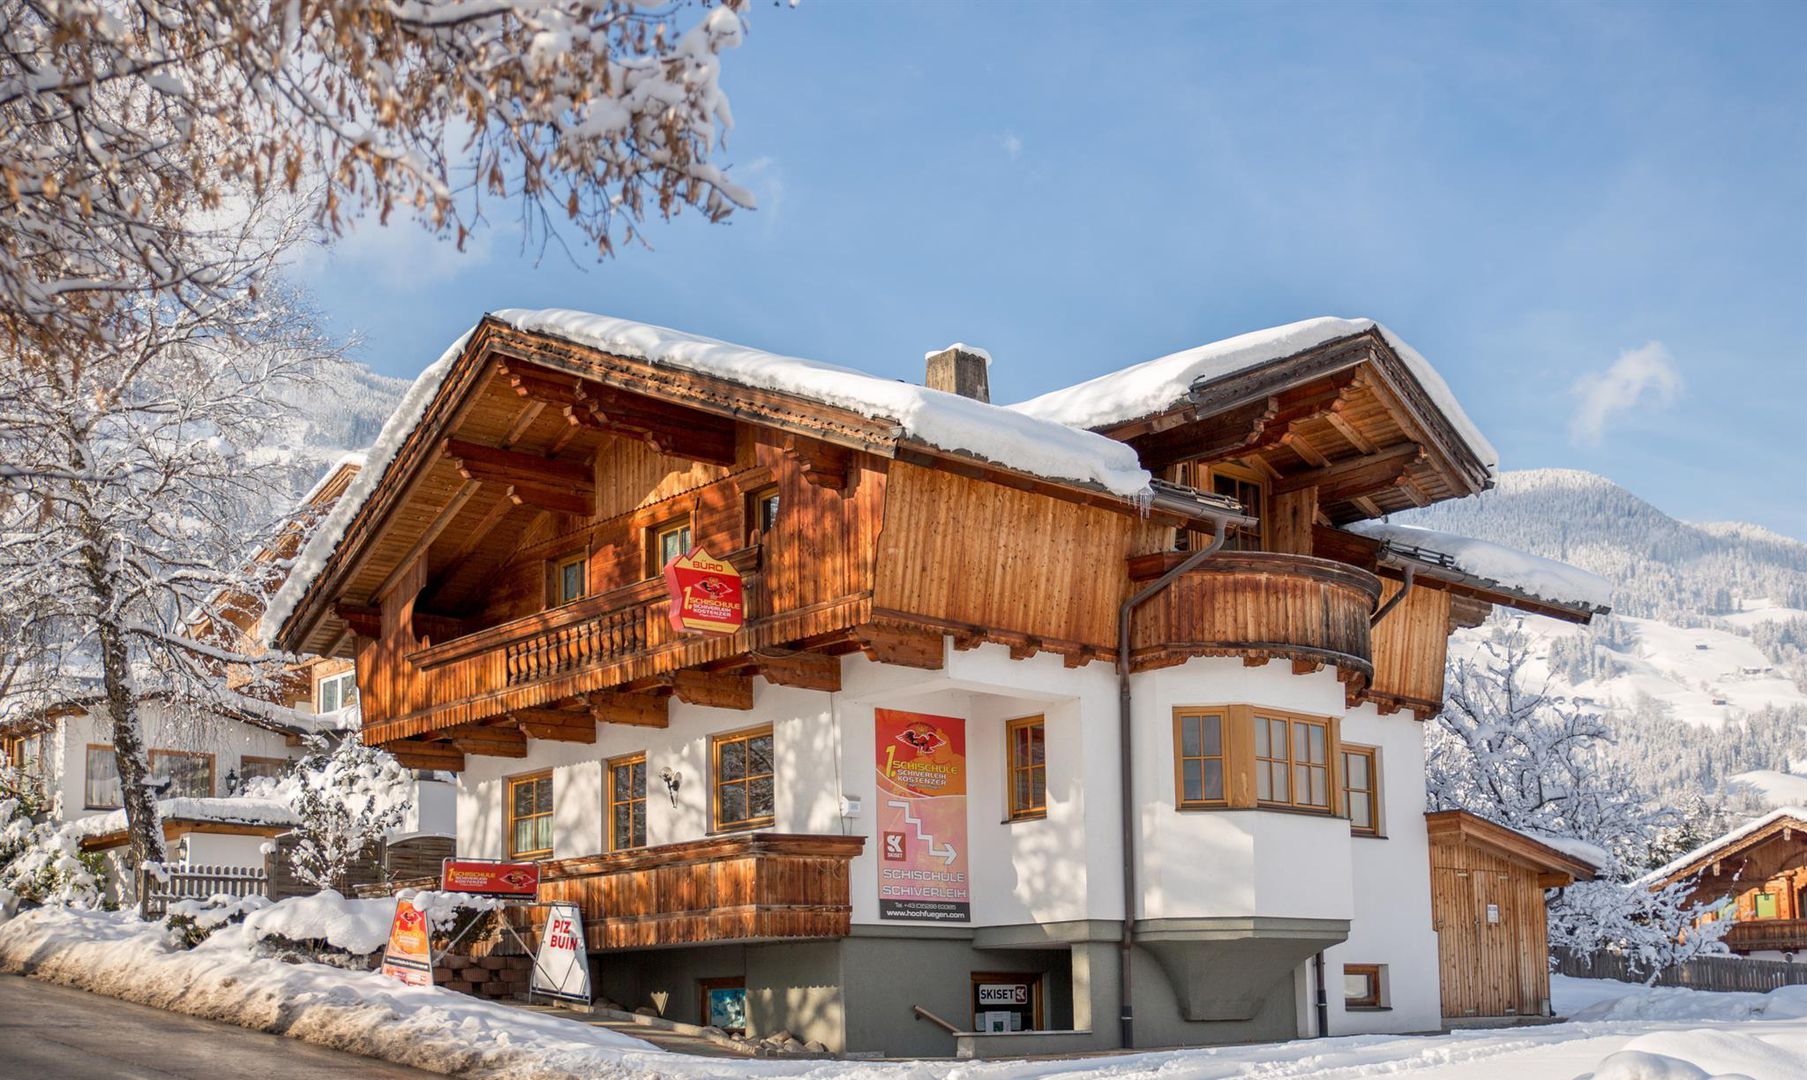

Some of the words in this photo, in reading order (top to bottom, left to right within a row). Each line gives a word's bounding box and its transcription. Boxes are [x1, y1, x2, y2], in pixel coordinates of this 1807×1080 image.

[693, 559, 724, 572] BÜRO
[683, 586, 693, 610] 1.
[690, 597, 741, 609] SCHISCHULE
[885, 744, 896, 777] 1.
[892, 760, 958, 774] SCHISCHULE
[896, 768, 947, 779] SCHIVERLEIH
[897, 775, 947, 785] KOSTENZER
[883, 868, 965, 882] SCHISCHULE
[882, 884, 967, 898] SCHIVERLEIH
[886, 910, 965, 919] www.hochfuegen.com
[553, 919, 572, 934] PIZ
[550, 935, 578, 951] BUIN
[980, 988, 1014, 999] SKISET
